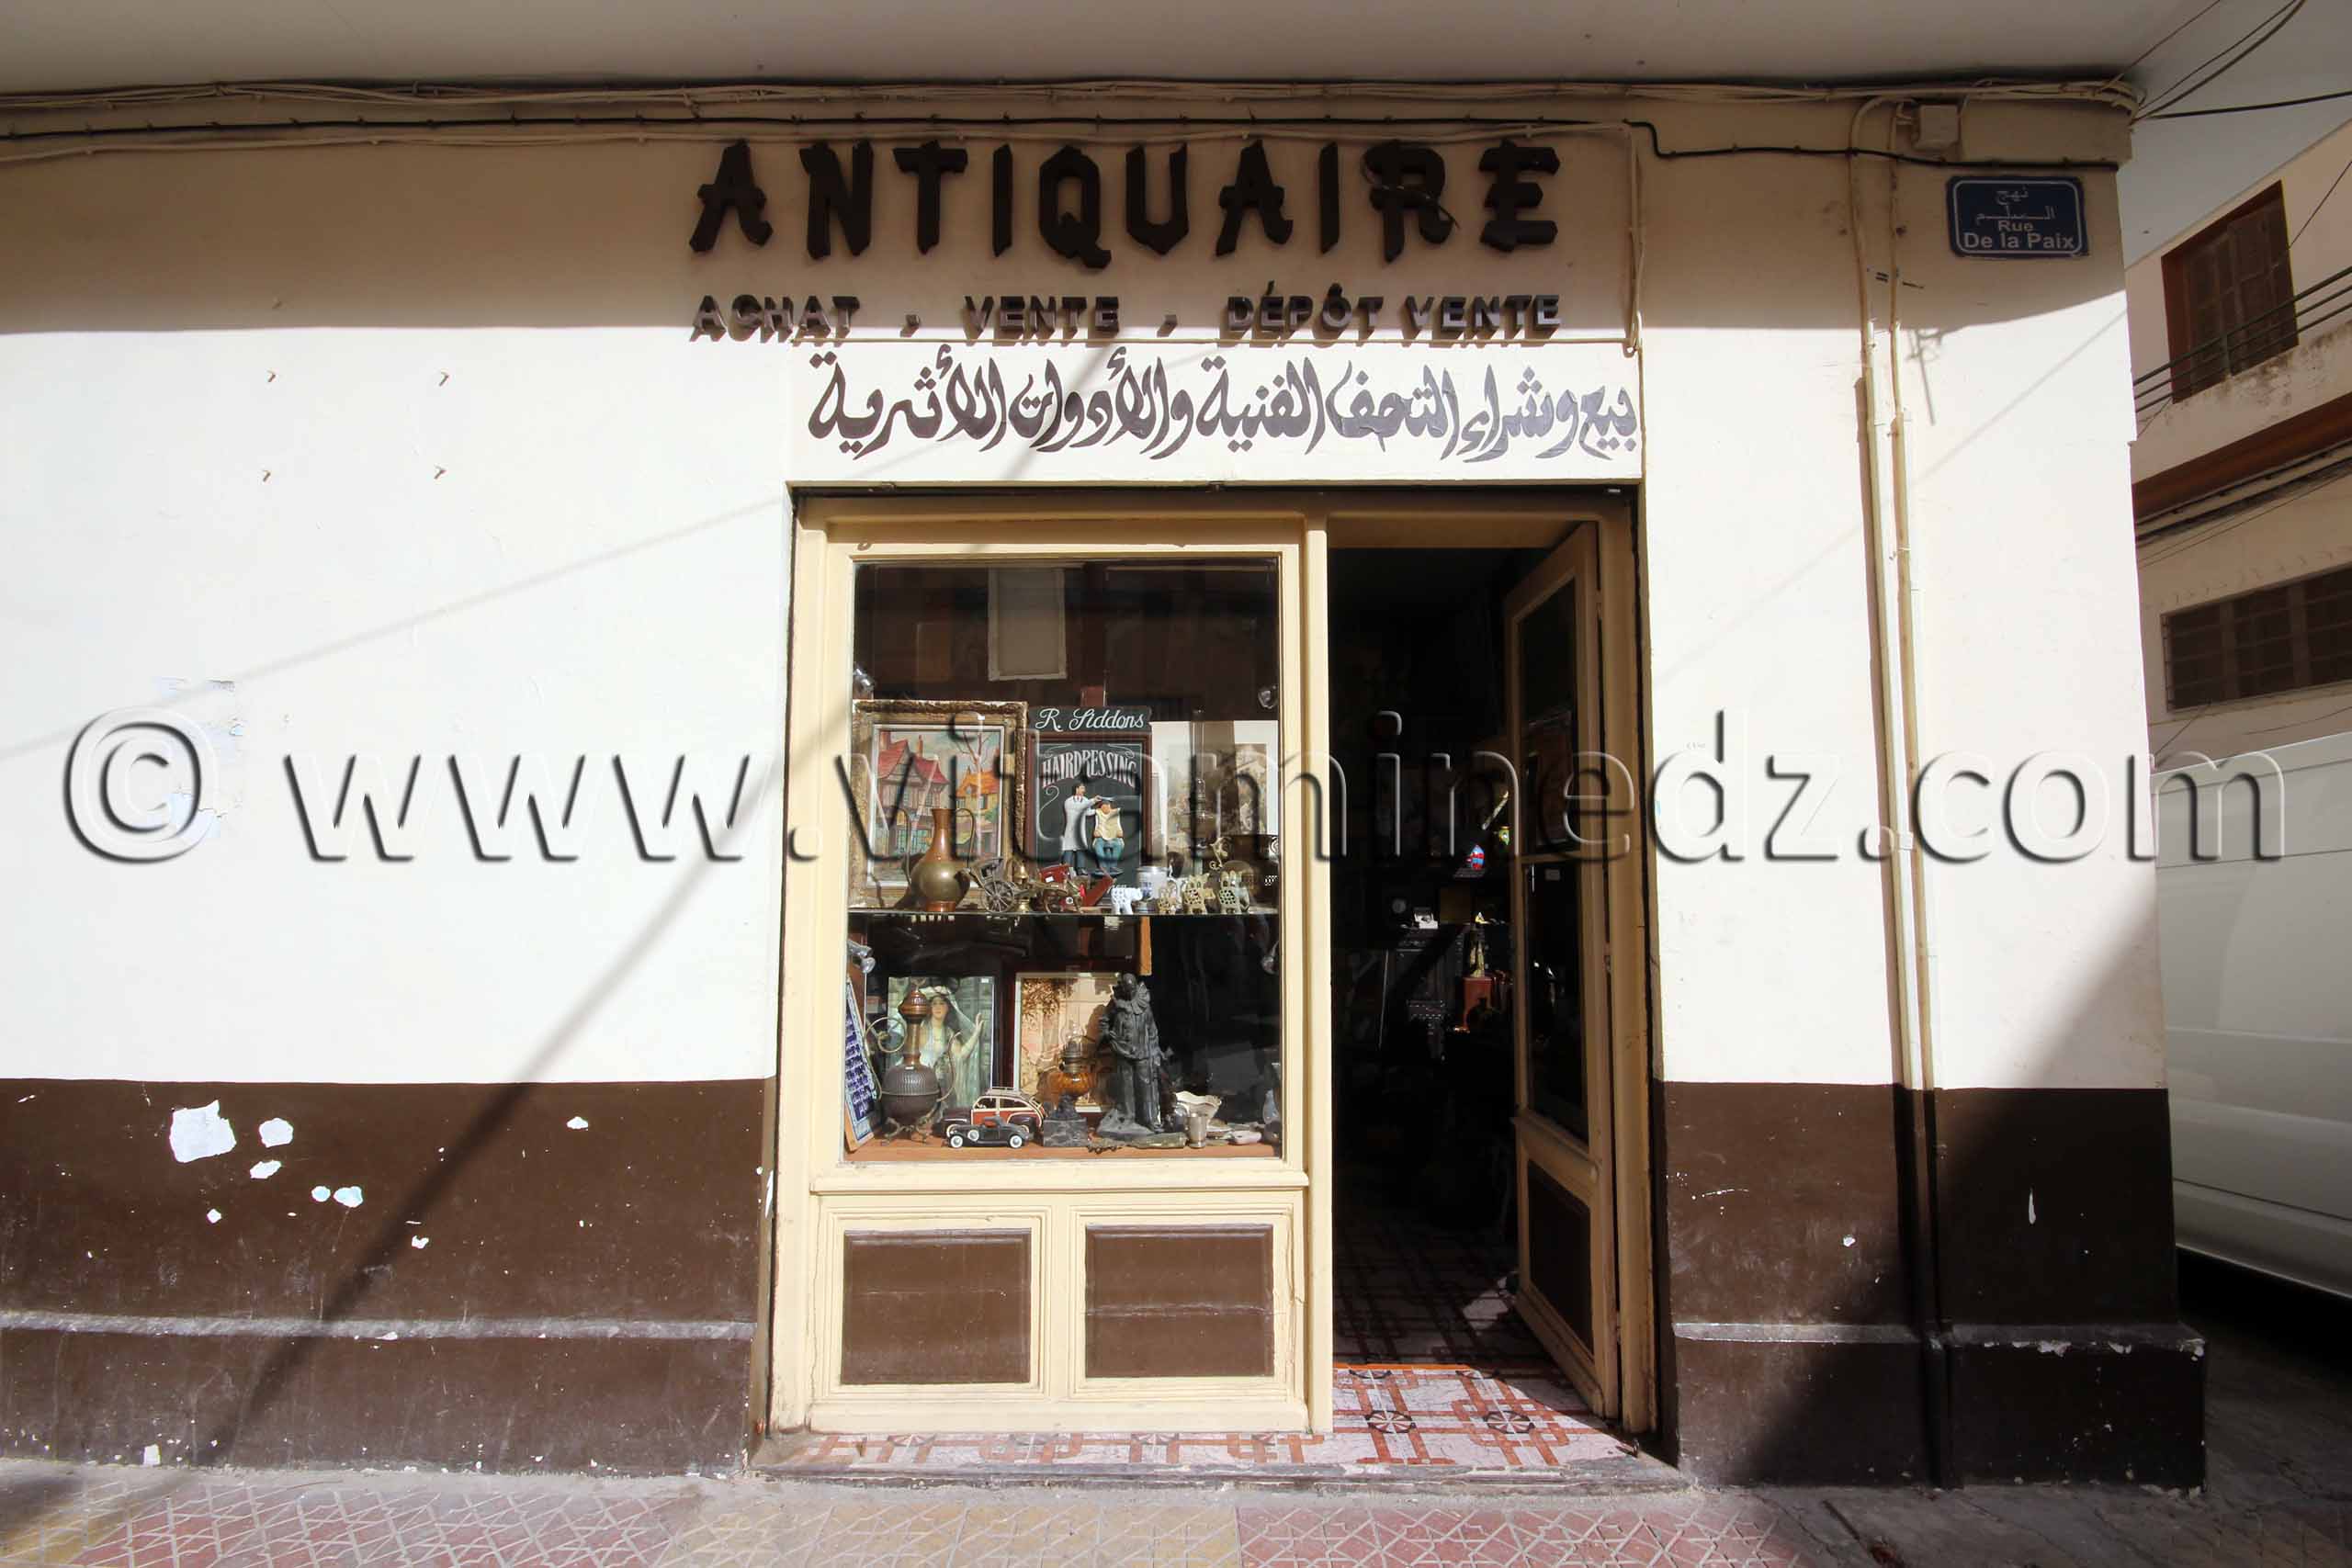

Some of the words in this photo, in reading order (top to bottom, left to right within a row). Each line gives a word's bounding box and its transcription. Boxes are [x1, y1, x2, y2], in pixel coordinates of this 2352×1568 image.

[689, 139, 1560, 270] ANTIQUAIRE
[1997, 220, 2034, 231] Rue
[1963, 232, 1993, 248] De
[2001, 232, 2019, 248] la
[2028, 232, 2075, 249] Paix
[693, 294, 860, 334] ACHAT
[964, 295, 1120, 334] VENTE
[1227, 280, 1384, 332] DÉPÔT
[1405, 294, 1562, 333] VENTE
[1195, 355, 1327, 456] الفنية
[1325, 360, 1458, 461] التحف
[1457, 364, 1578, 463] وشراء
[1578, 385, 1638, 461] بيع
[1035, 708, 1063, 732] R.
[1042, 749, 1137, 788] HAIRDRESSING
